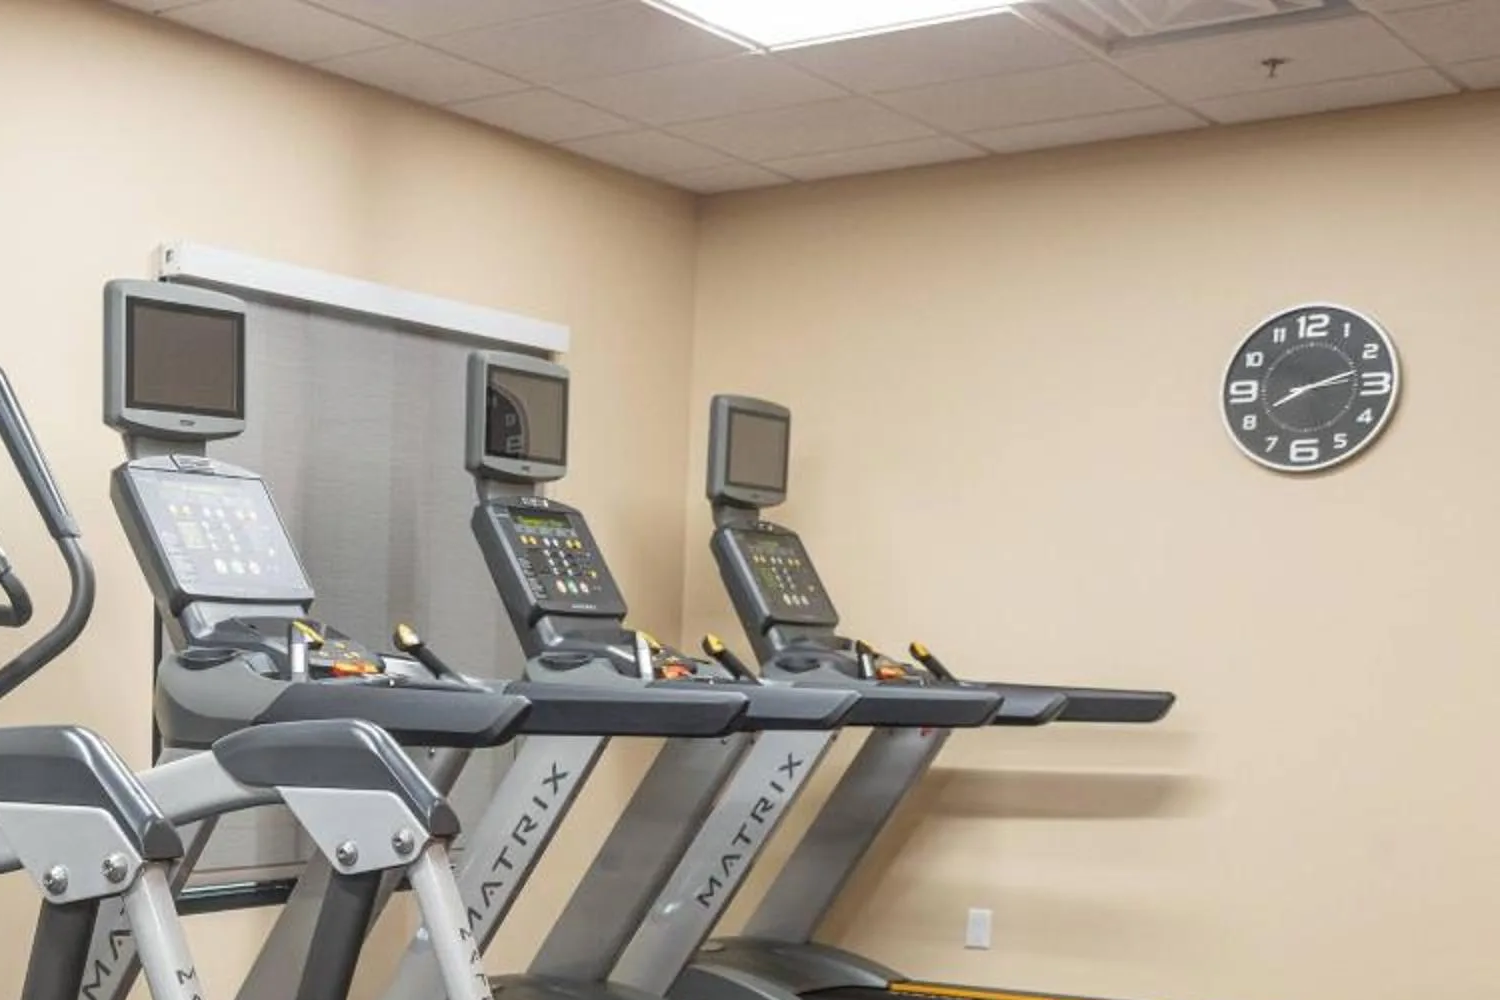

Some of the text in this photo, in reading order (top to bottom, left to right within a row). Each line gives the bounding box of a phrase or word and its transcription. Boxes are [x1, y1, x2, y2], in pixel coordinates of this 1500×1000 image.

[1297, 313, 1331, 339] 12
[1343, 323, 1351, 338] 1
[1273, 327, 1287, 343] 11
[1245, 351, 1264, 368] 10
[1362, 343, 1379, 360] 2
[1360, 371, 1391, 396] 3
[1229, 380, 1259, 405] 9
[1242, 414, 1257, 430] 8
[1356, 408, 1373, 424] 4
[1264, 436, 1279, 452] 7
[1333, 433, 1348, 449] 5
[1289, 438, 1320, 462] 6
[697, 753, 804, 908] MATRIX
